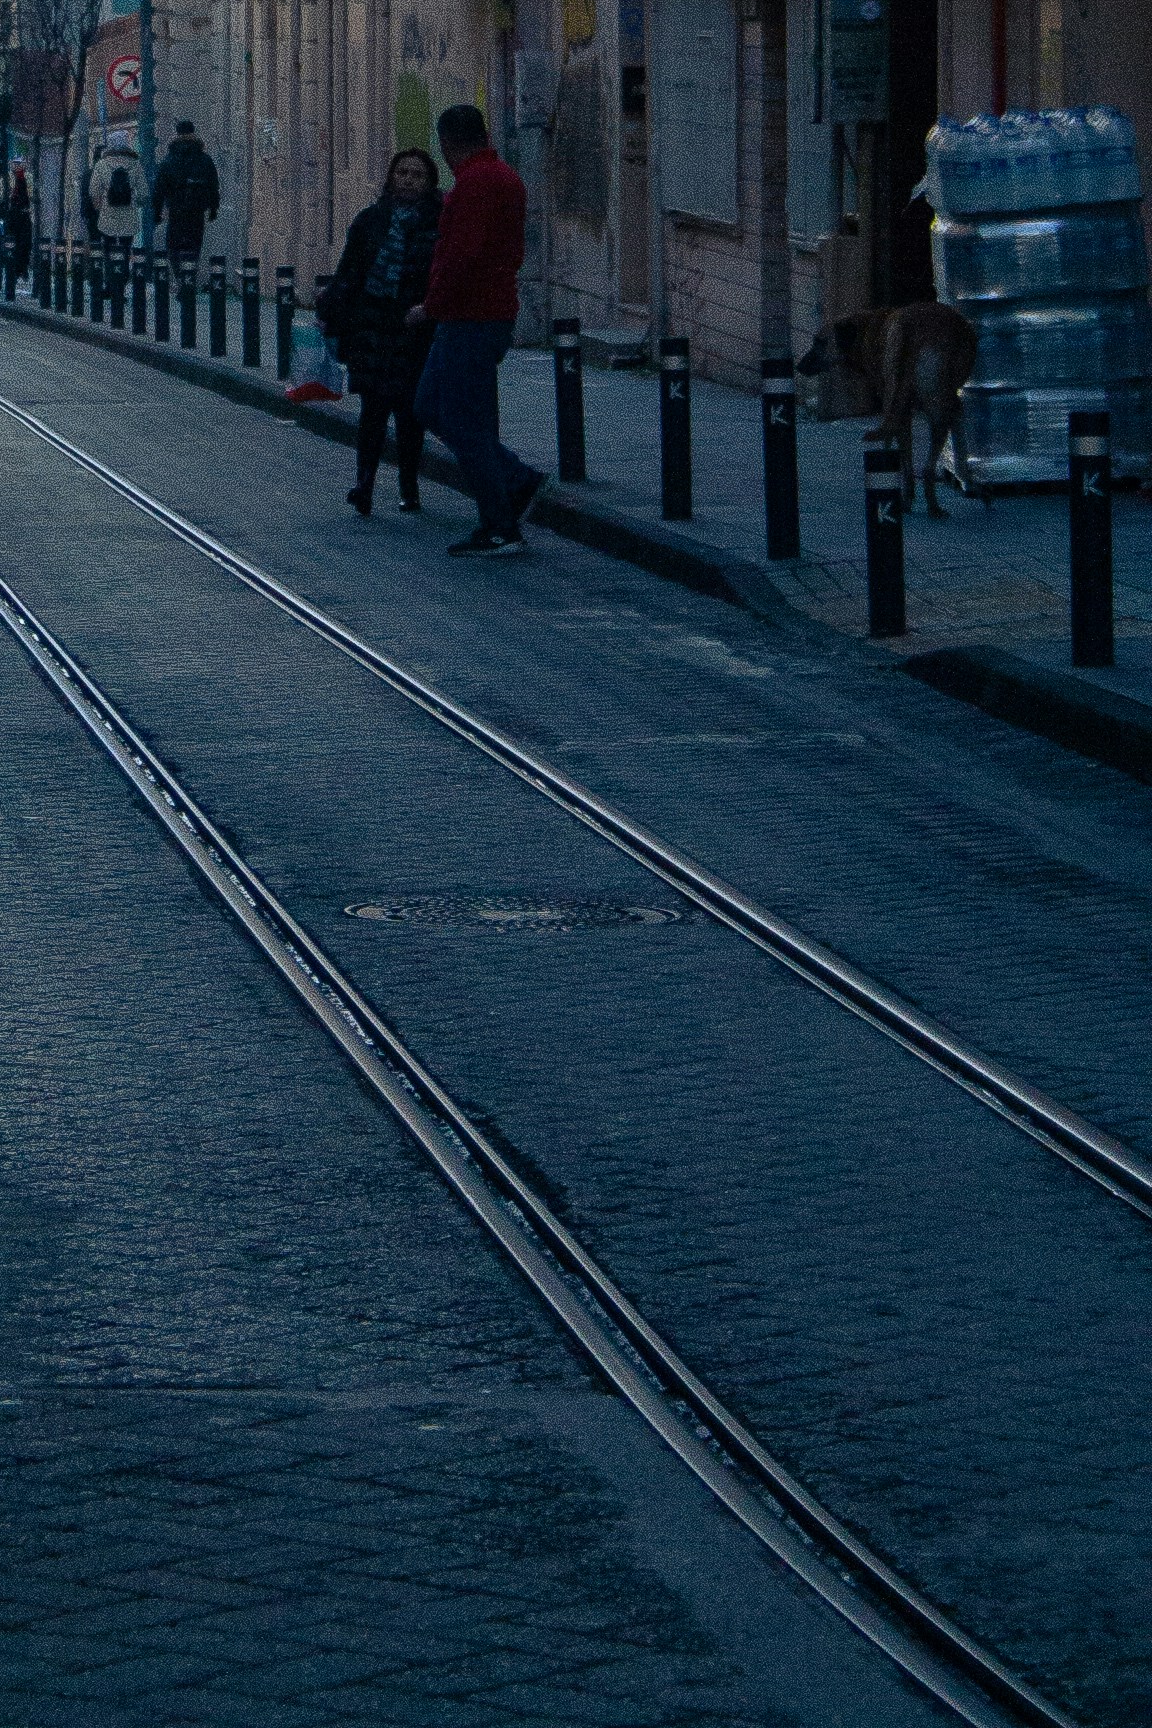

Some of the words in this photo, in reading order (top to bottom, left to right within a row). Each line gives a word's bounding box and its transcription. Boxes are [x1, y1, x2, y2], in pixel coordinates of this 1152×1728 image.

[562, 357, 578, 374] K
[669, 380, 686, 400] K
[770, 404, 788, 425] K
[1083, 471, 1104, 497] K
[877, 501, 897, 524] K
